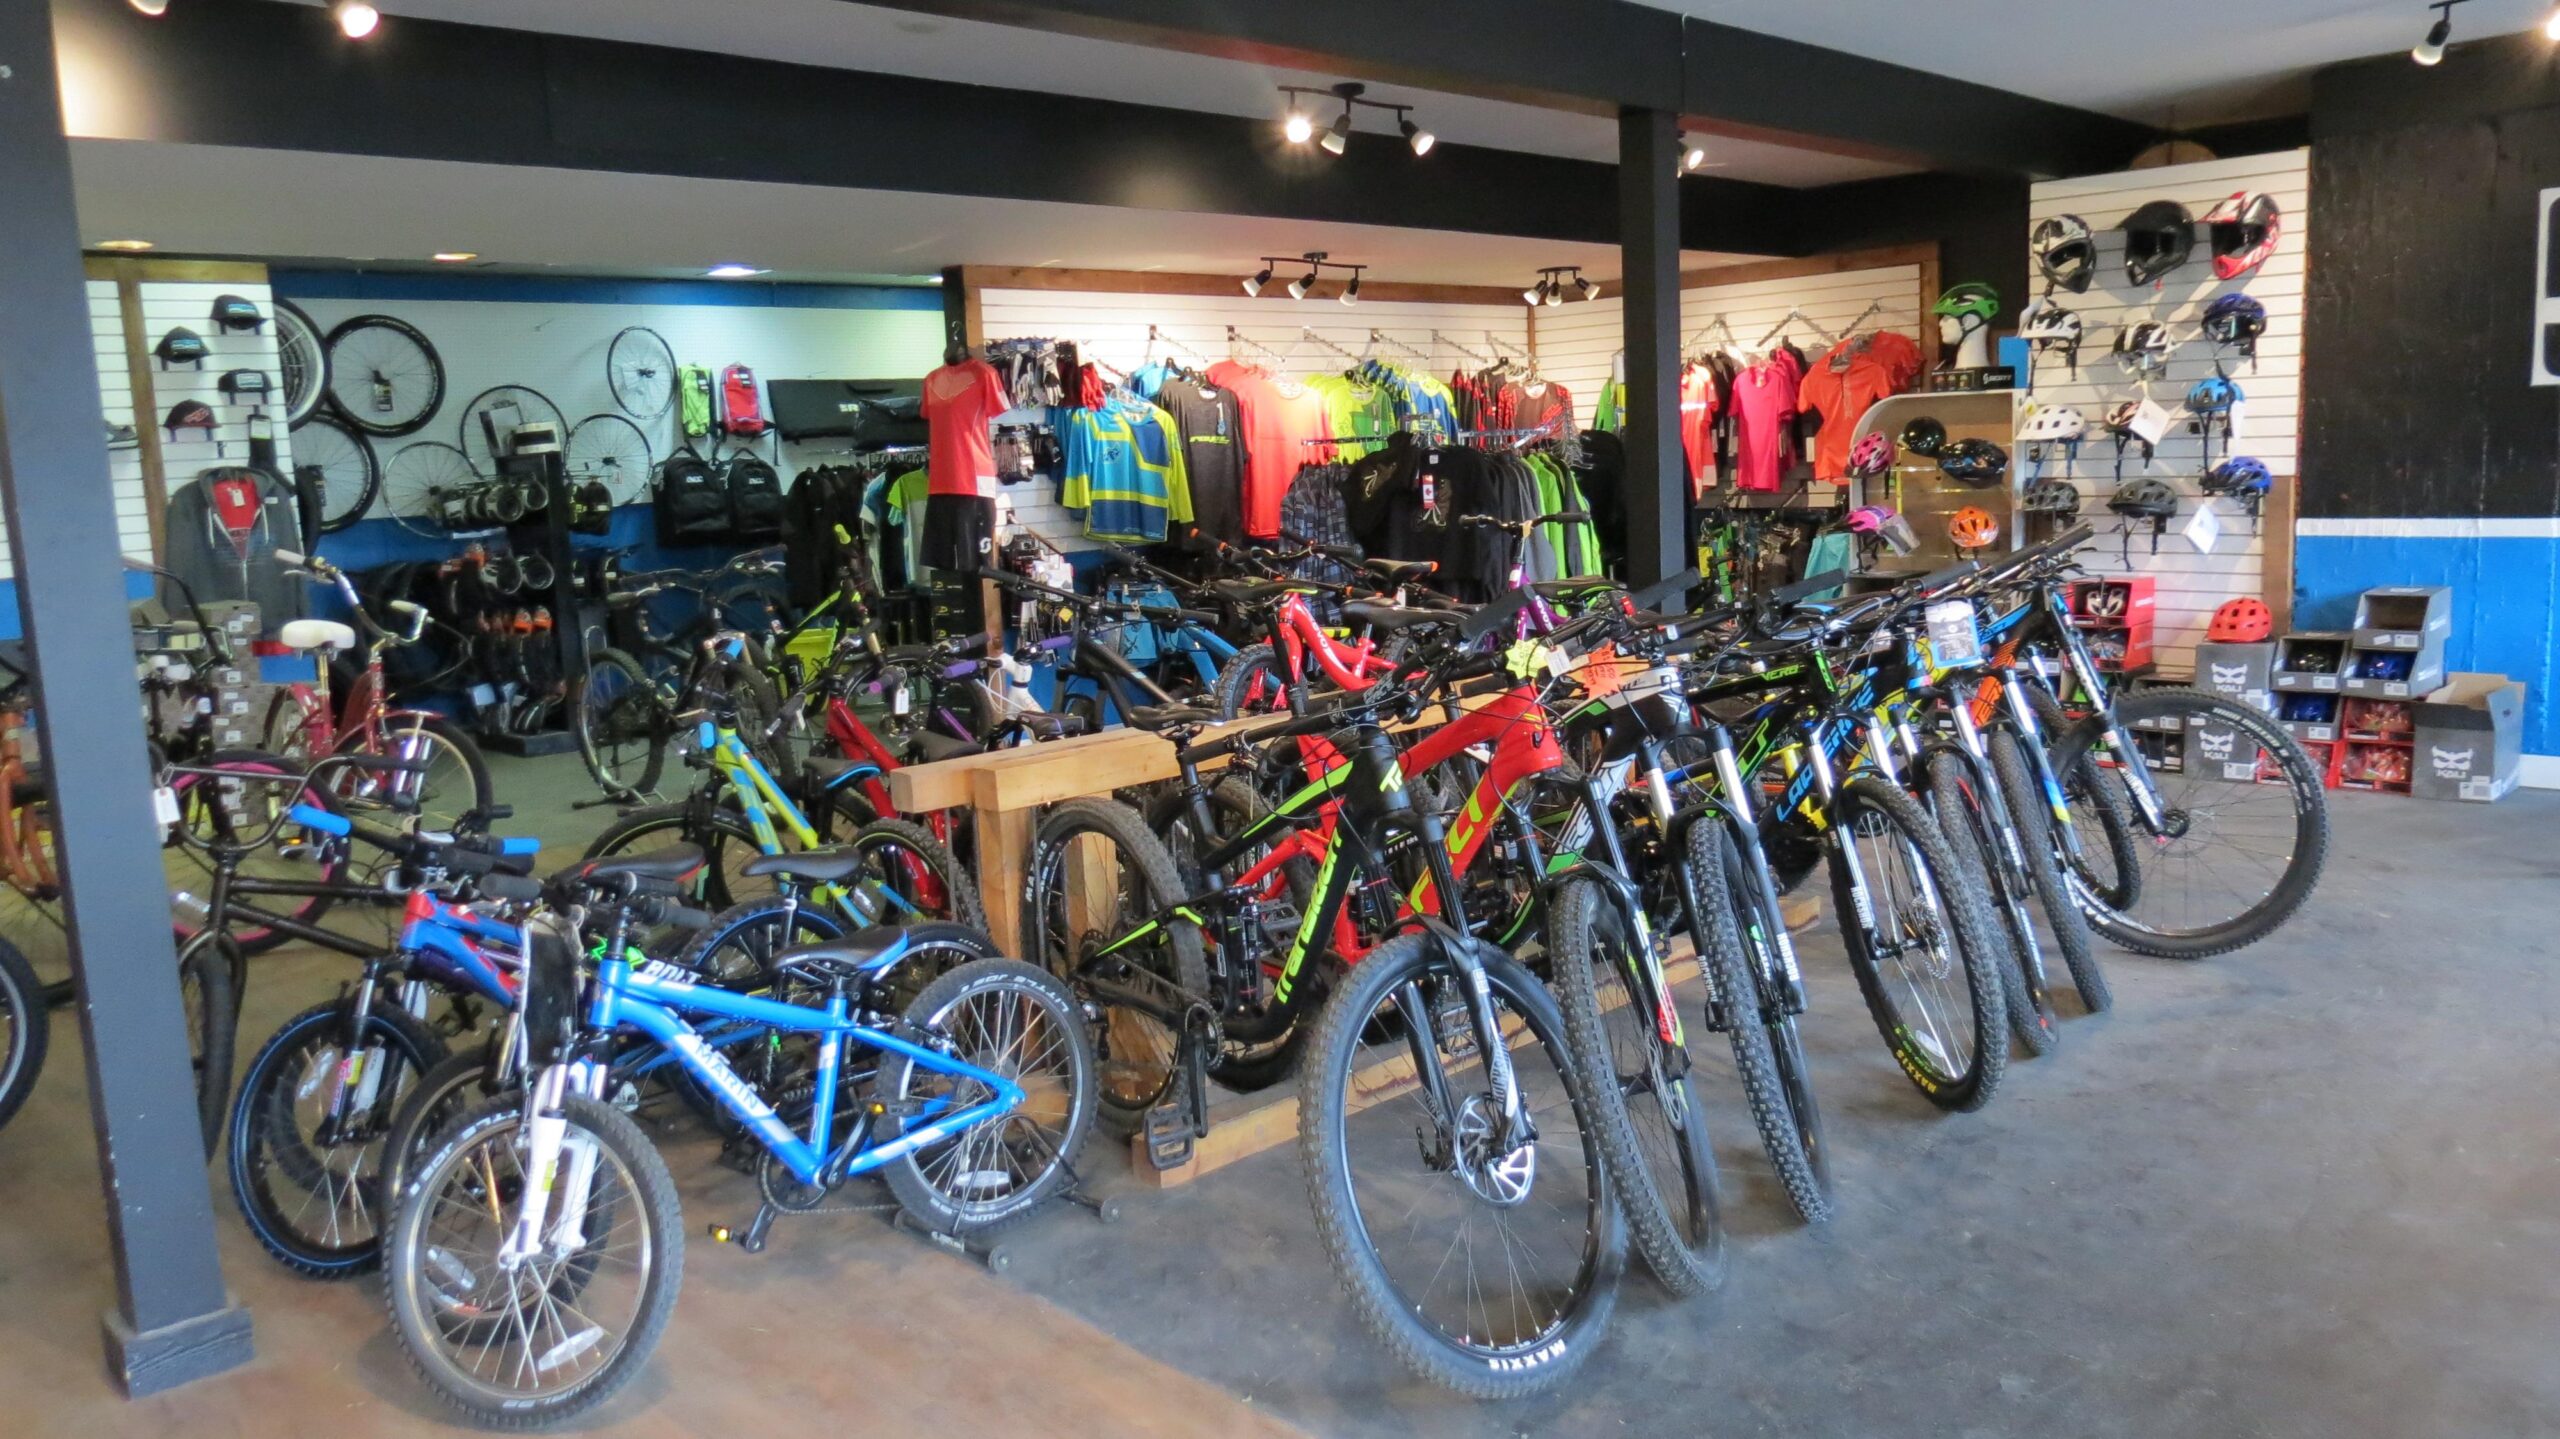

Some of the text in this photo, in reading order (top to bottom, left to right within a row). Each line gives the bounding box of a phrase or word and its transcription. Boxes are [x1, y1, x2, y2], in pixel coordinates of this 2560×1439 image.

[1409, 776, 1484, 914] FLT
[694, 1044, 760, 1110] MARIN
[1896, 1048, 1937, 1094] MAXXIS
[1488, 1338, 1566, 1372] MAXXIS
